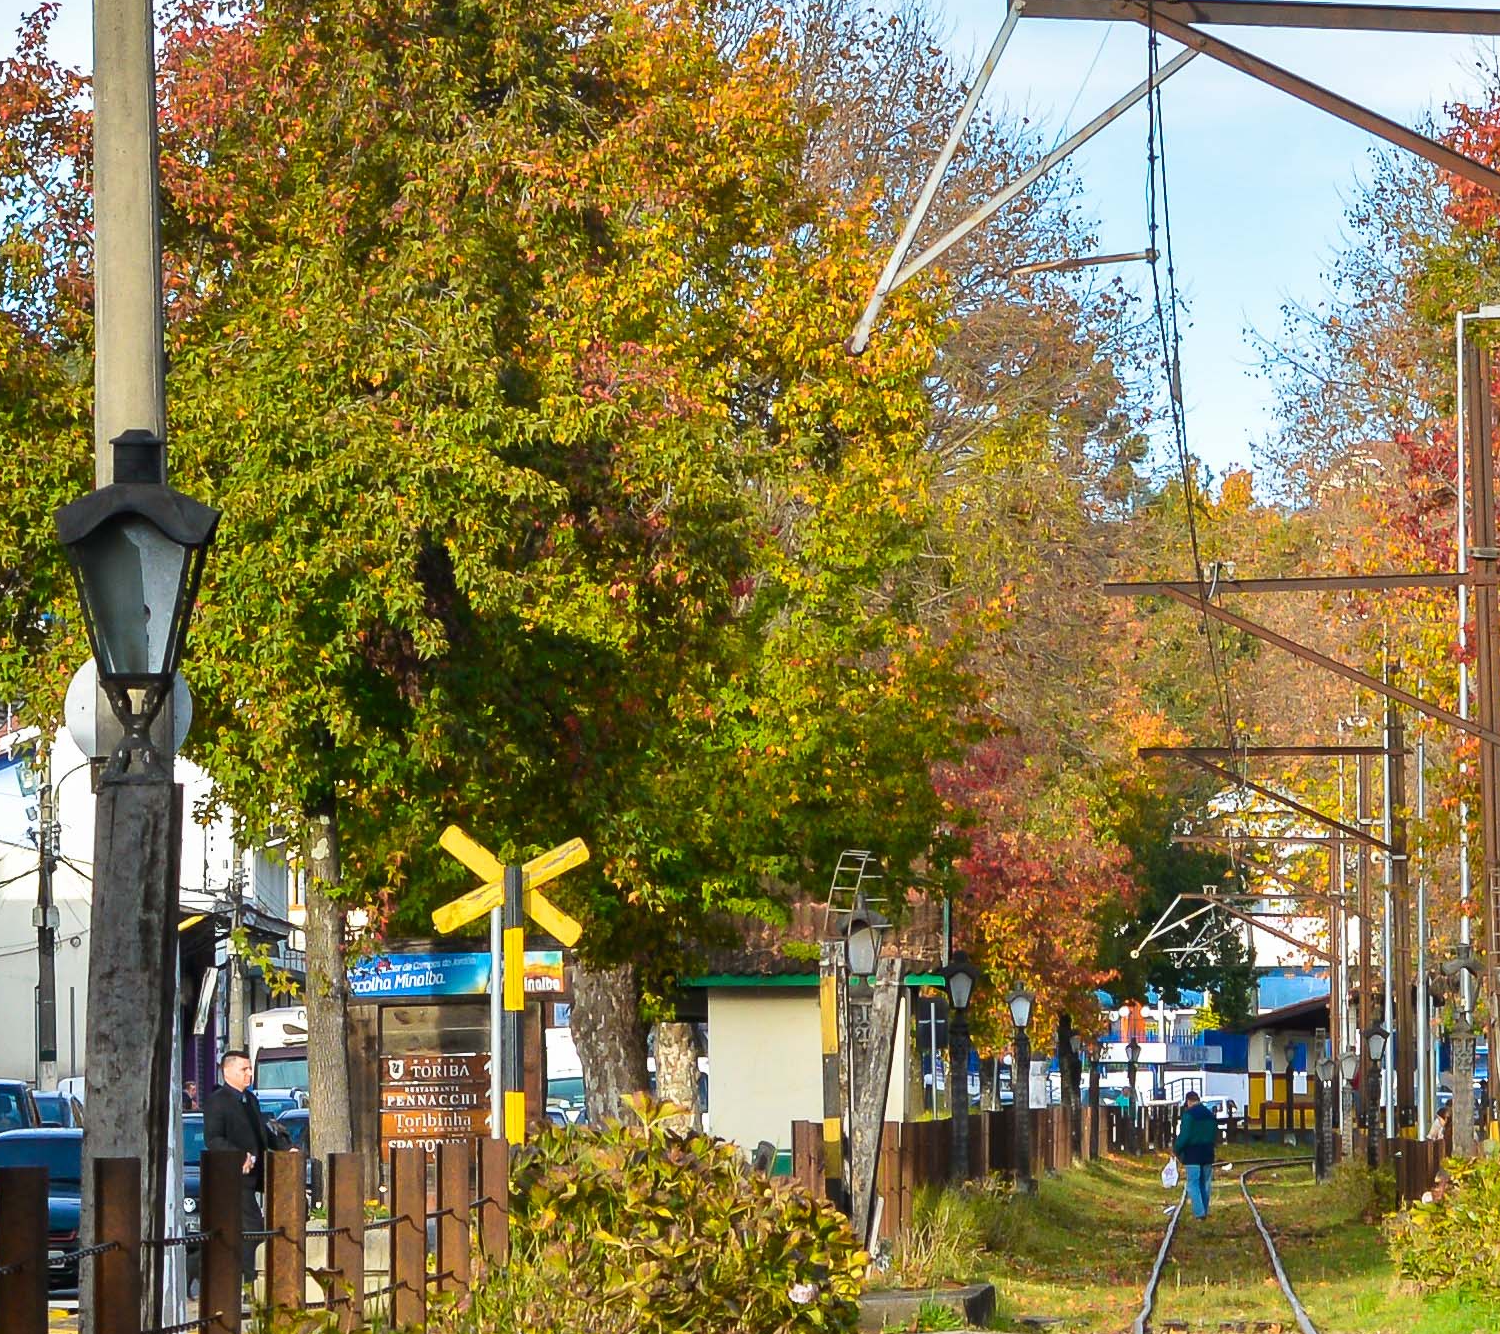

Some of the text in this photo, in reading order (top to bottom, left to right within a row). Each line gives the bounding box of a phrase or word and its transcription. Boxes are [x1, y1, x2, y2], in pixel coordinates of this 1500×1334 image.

[410, 1064, 470, 1078] TORIBA
[387, 1093, 477, 1107] PENNACCHI
[394, 1111, 472, 1127] Toribinha
